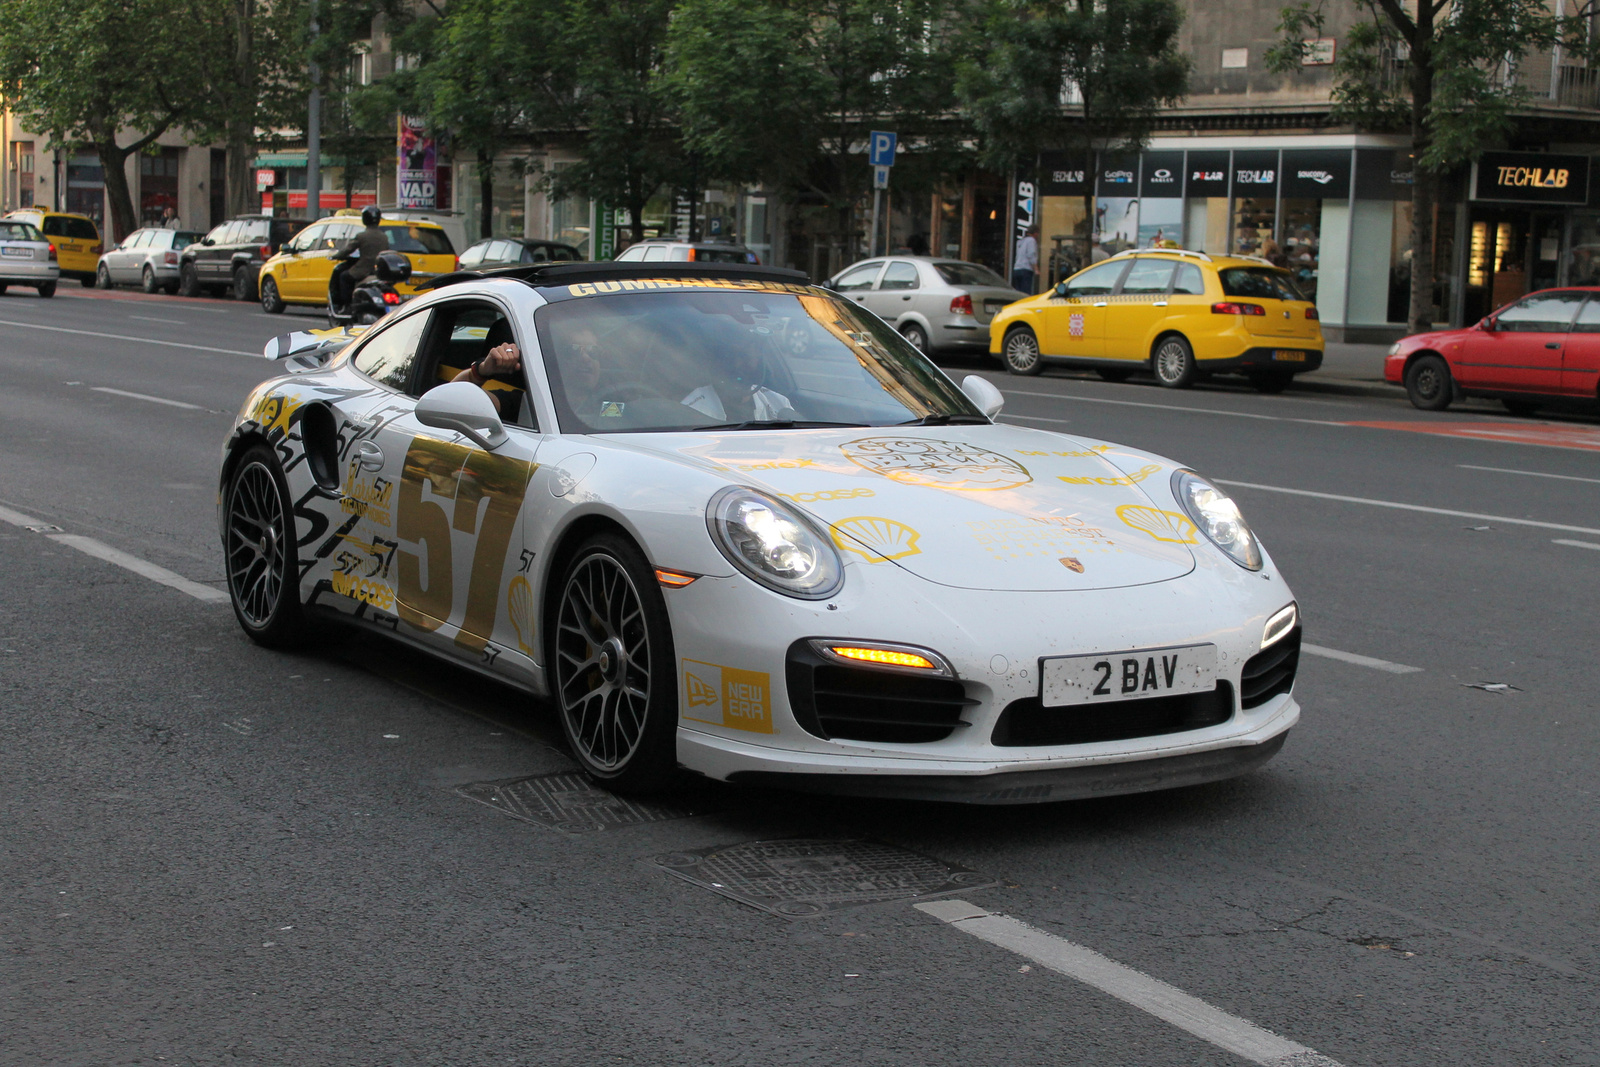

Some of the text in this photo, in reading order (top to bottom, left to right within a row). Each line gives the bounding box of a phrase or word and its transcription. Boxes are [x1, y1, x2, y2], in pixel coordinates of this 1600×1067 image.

[875, 134, 890, 162] P
[1192, 171, 1224, 181] POLAR
[1236, 170, 1275, 184] TECHLAB
[1497, 166, 1569, 188] TECHLAB
[401, 182, 435, 198] VAD
[396, 433, 541, 656] 57
[518, 548, 537, 573] 57
[1092, 654, 1179, 696] 2 BAV
[728, 681, 763, 703] NEW
[729, 699, 765, 721] ERA
